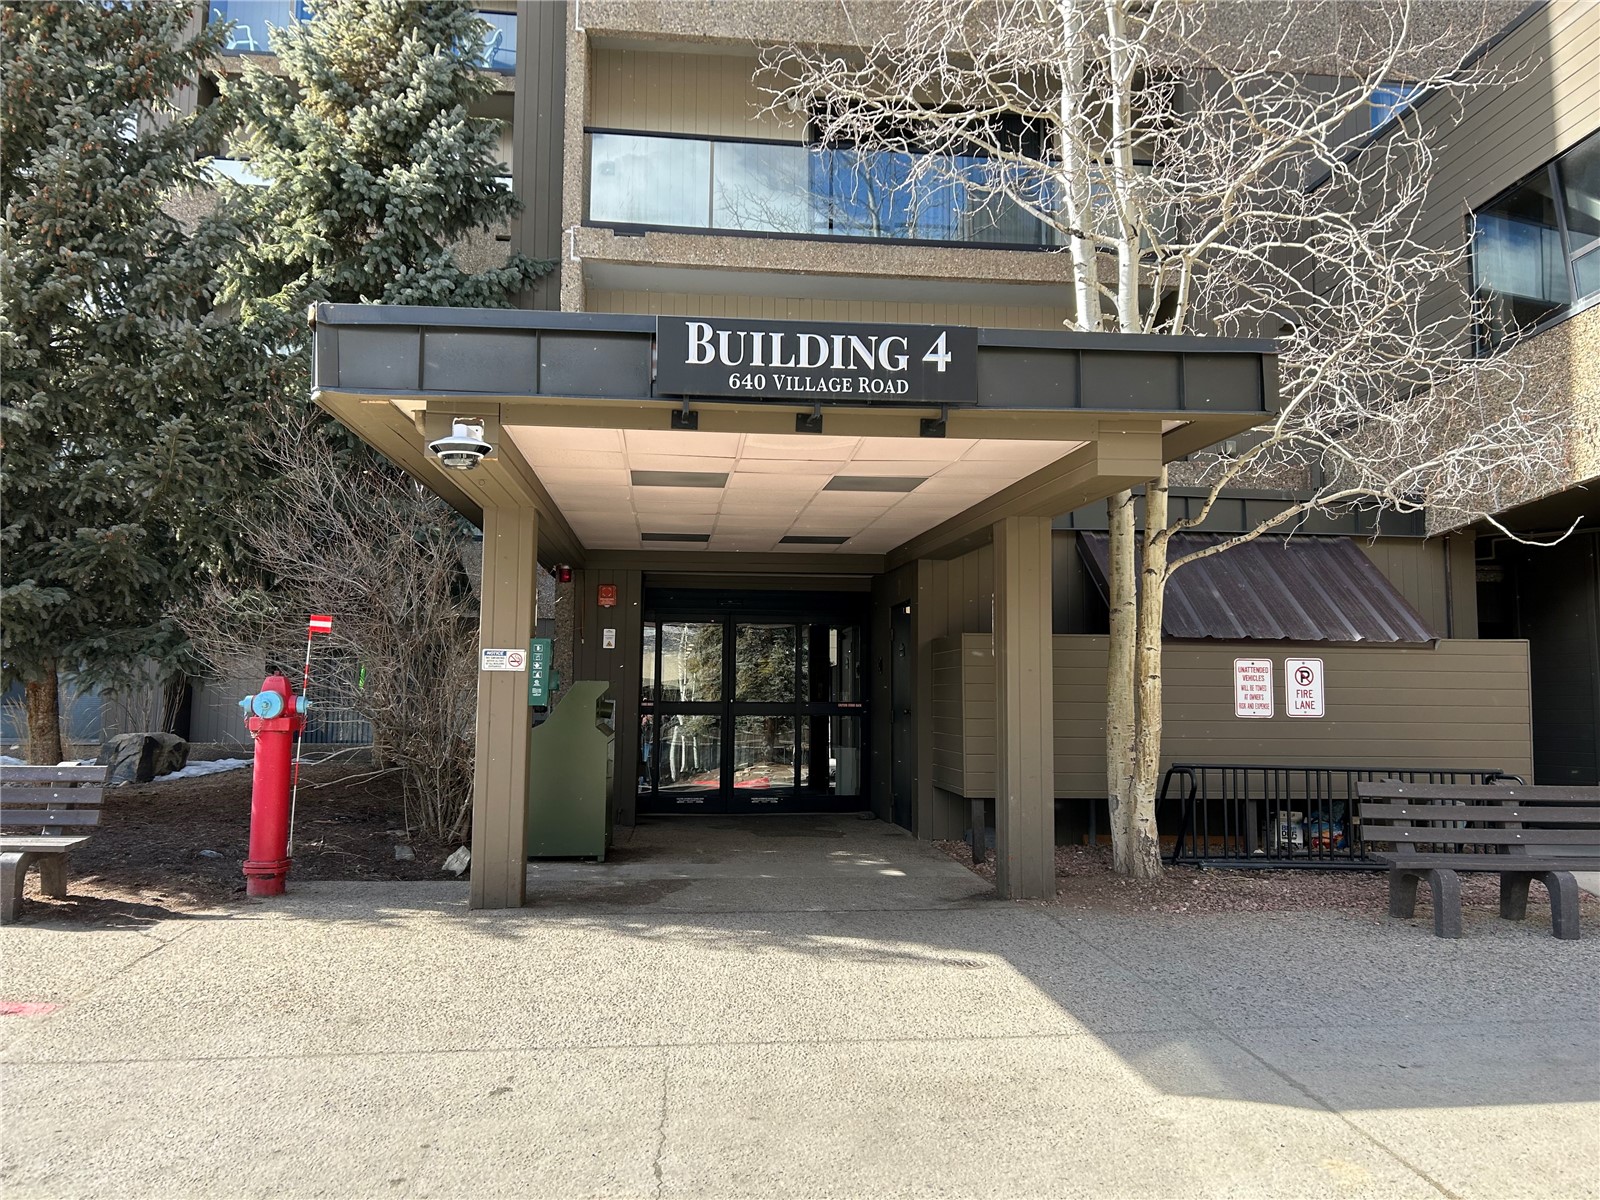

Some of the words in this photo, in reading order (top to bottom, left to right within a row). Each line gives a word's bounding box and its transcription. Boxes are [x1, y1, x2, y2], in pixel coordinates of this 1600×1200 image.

[685, 321, 910, 371] BUILDING
[922, 330, 952, 372] 4
[728, 373, 766, 391] 640
[772, 374, 852, 393] VILLAGE
[858, 377, 909, 394] ROAD
[1296, 689, 1313, 698] FIRE
[1295, 701, 1315, 709] LANE
